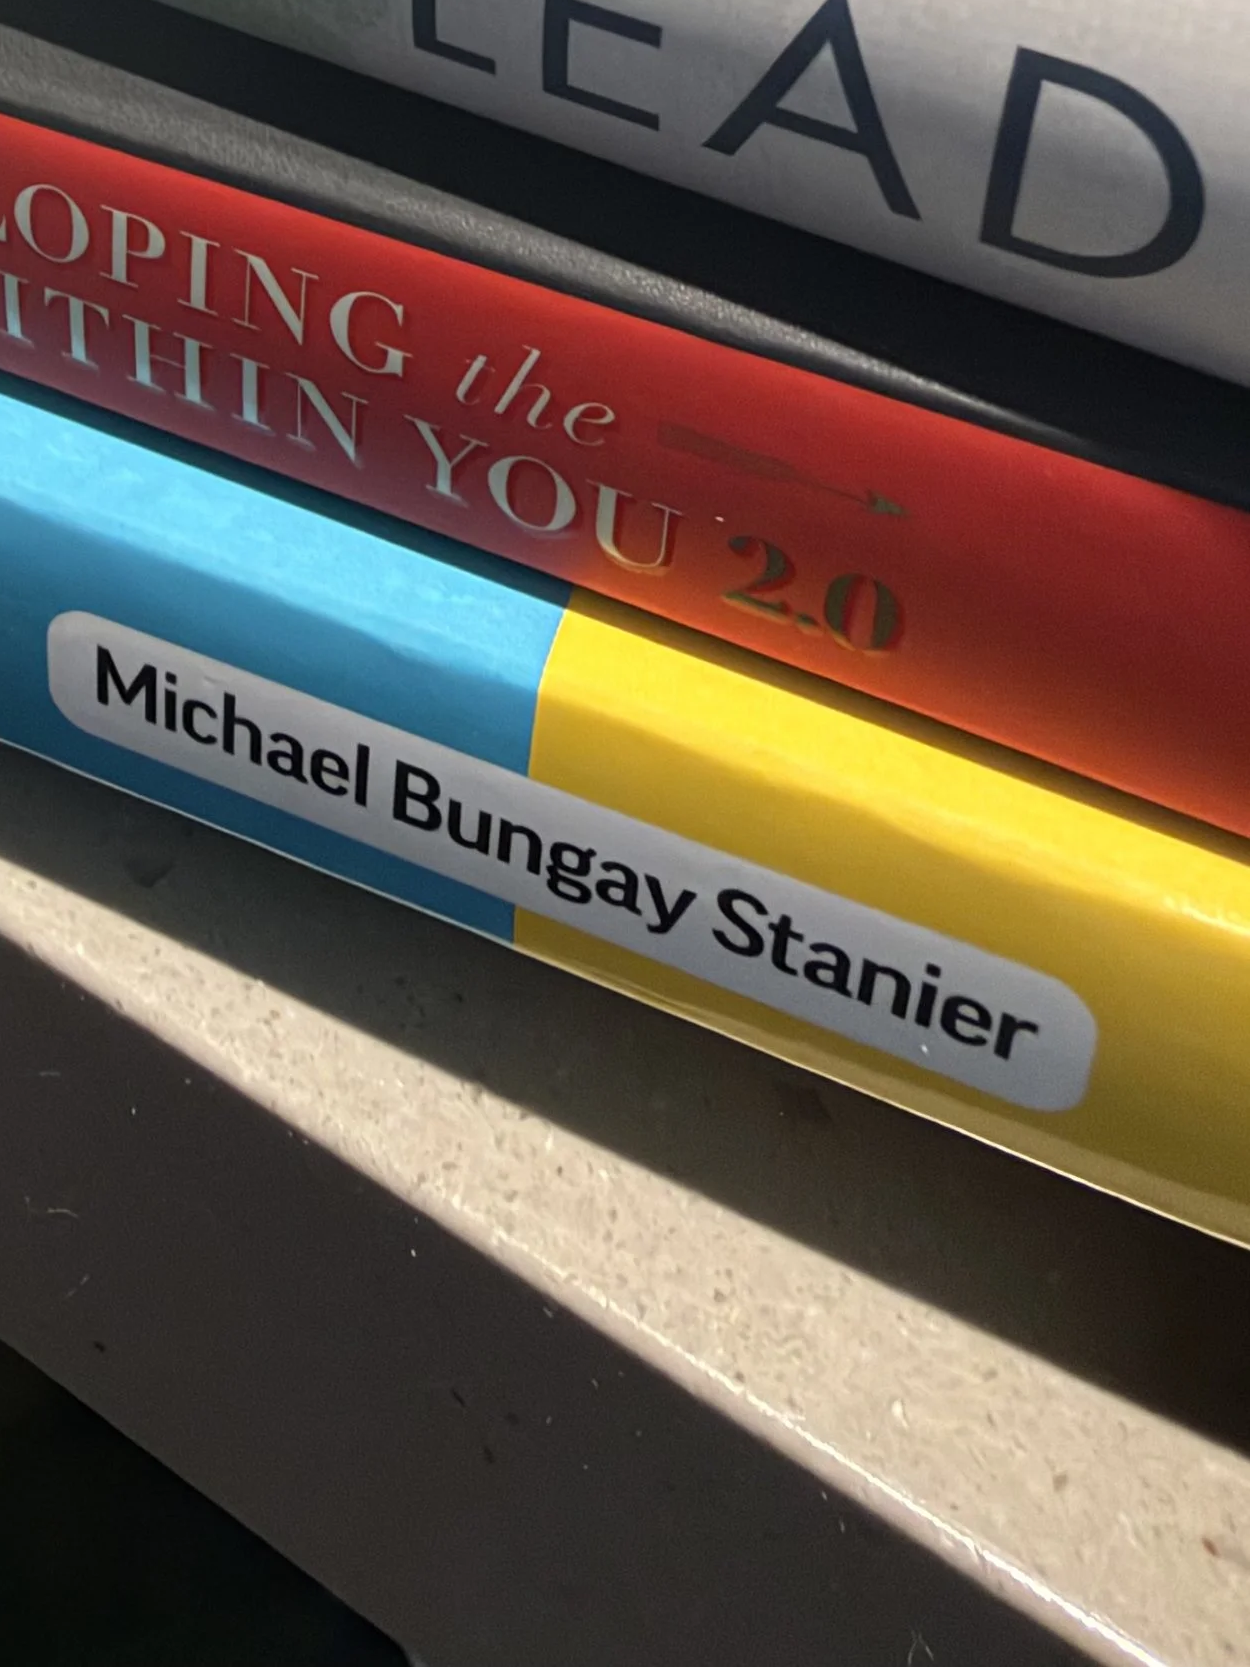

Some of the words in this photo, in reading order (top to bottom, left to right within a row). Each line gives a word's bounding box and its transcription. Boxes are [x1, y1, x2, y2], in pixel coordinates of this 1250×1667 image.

[455, 345, 616, 447] the
[403, 413, 684, 577] YOU
[721, 534, 904, 656] 2.0
[94, 646, 371, 808] Michael
[392, 759, 698, 935] Bungay
[711, 888, 1041, 1064] Stanier
